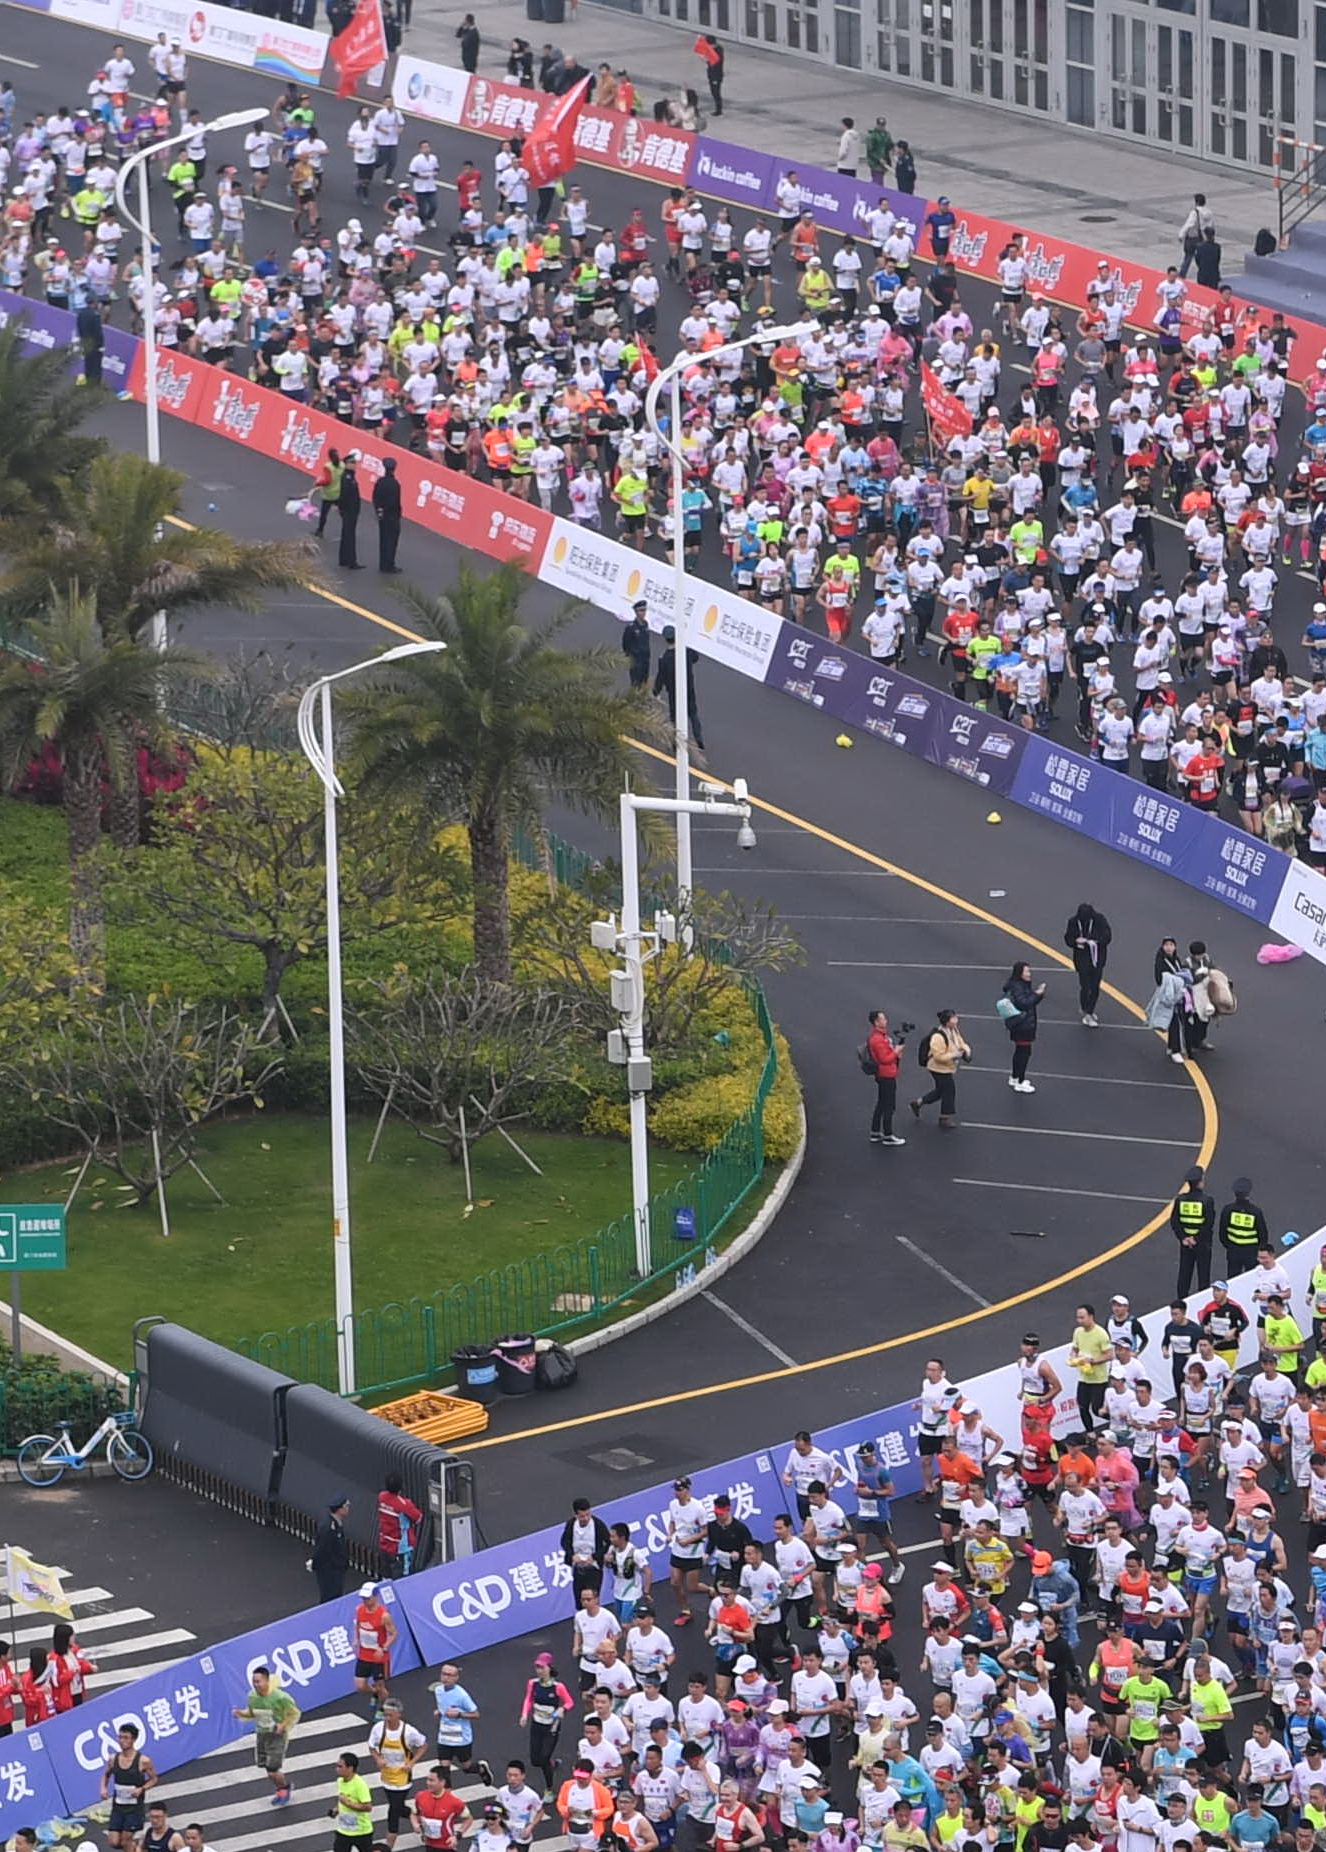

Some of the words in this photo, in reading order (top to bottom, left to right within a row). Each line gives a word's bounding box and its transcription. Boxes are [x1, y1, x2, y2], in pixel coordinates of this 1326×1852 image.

[490, 94, 539, 133] 肯德基
[640, 134, 691, 175] 肯德基
[432, 1574, 512, 1628] C&D
[144, 1685, 208, 1740] 建发
